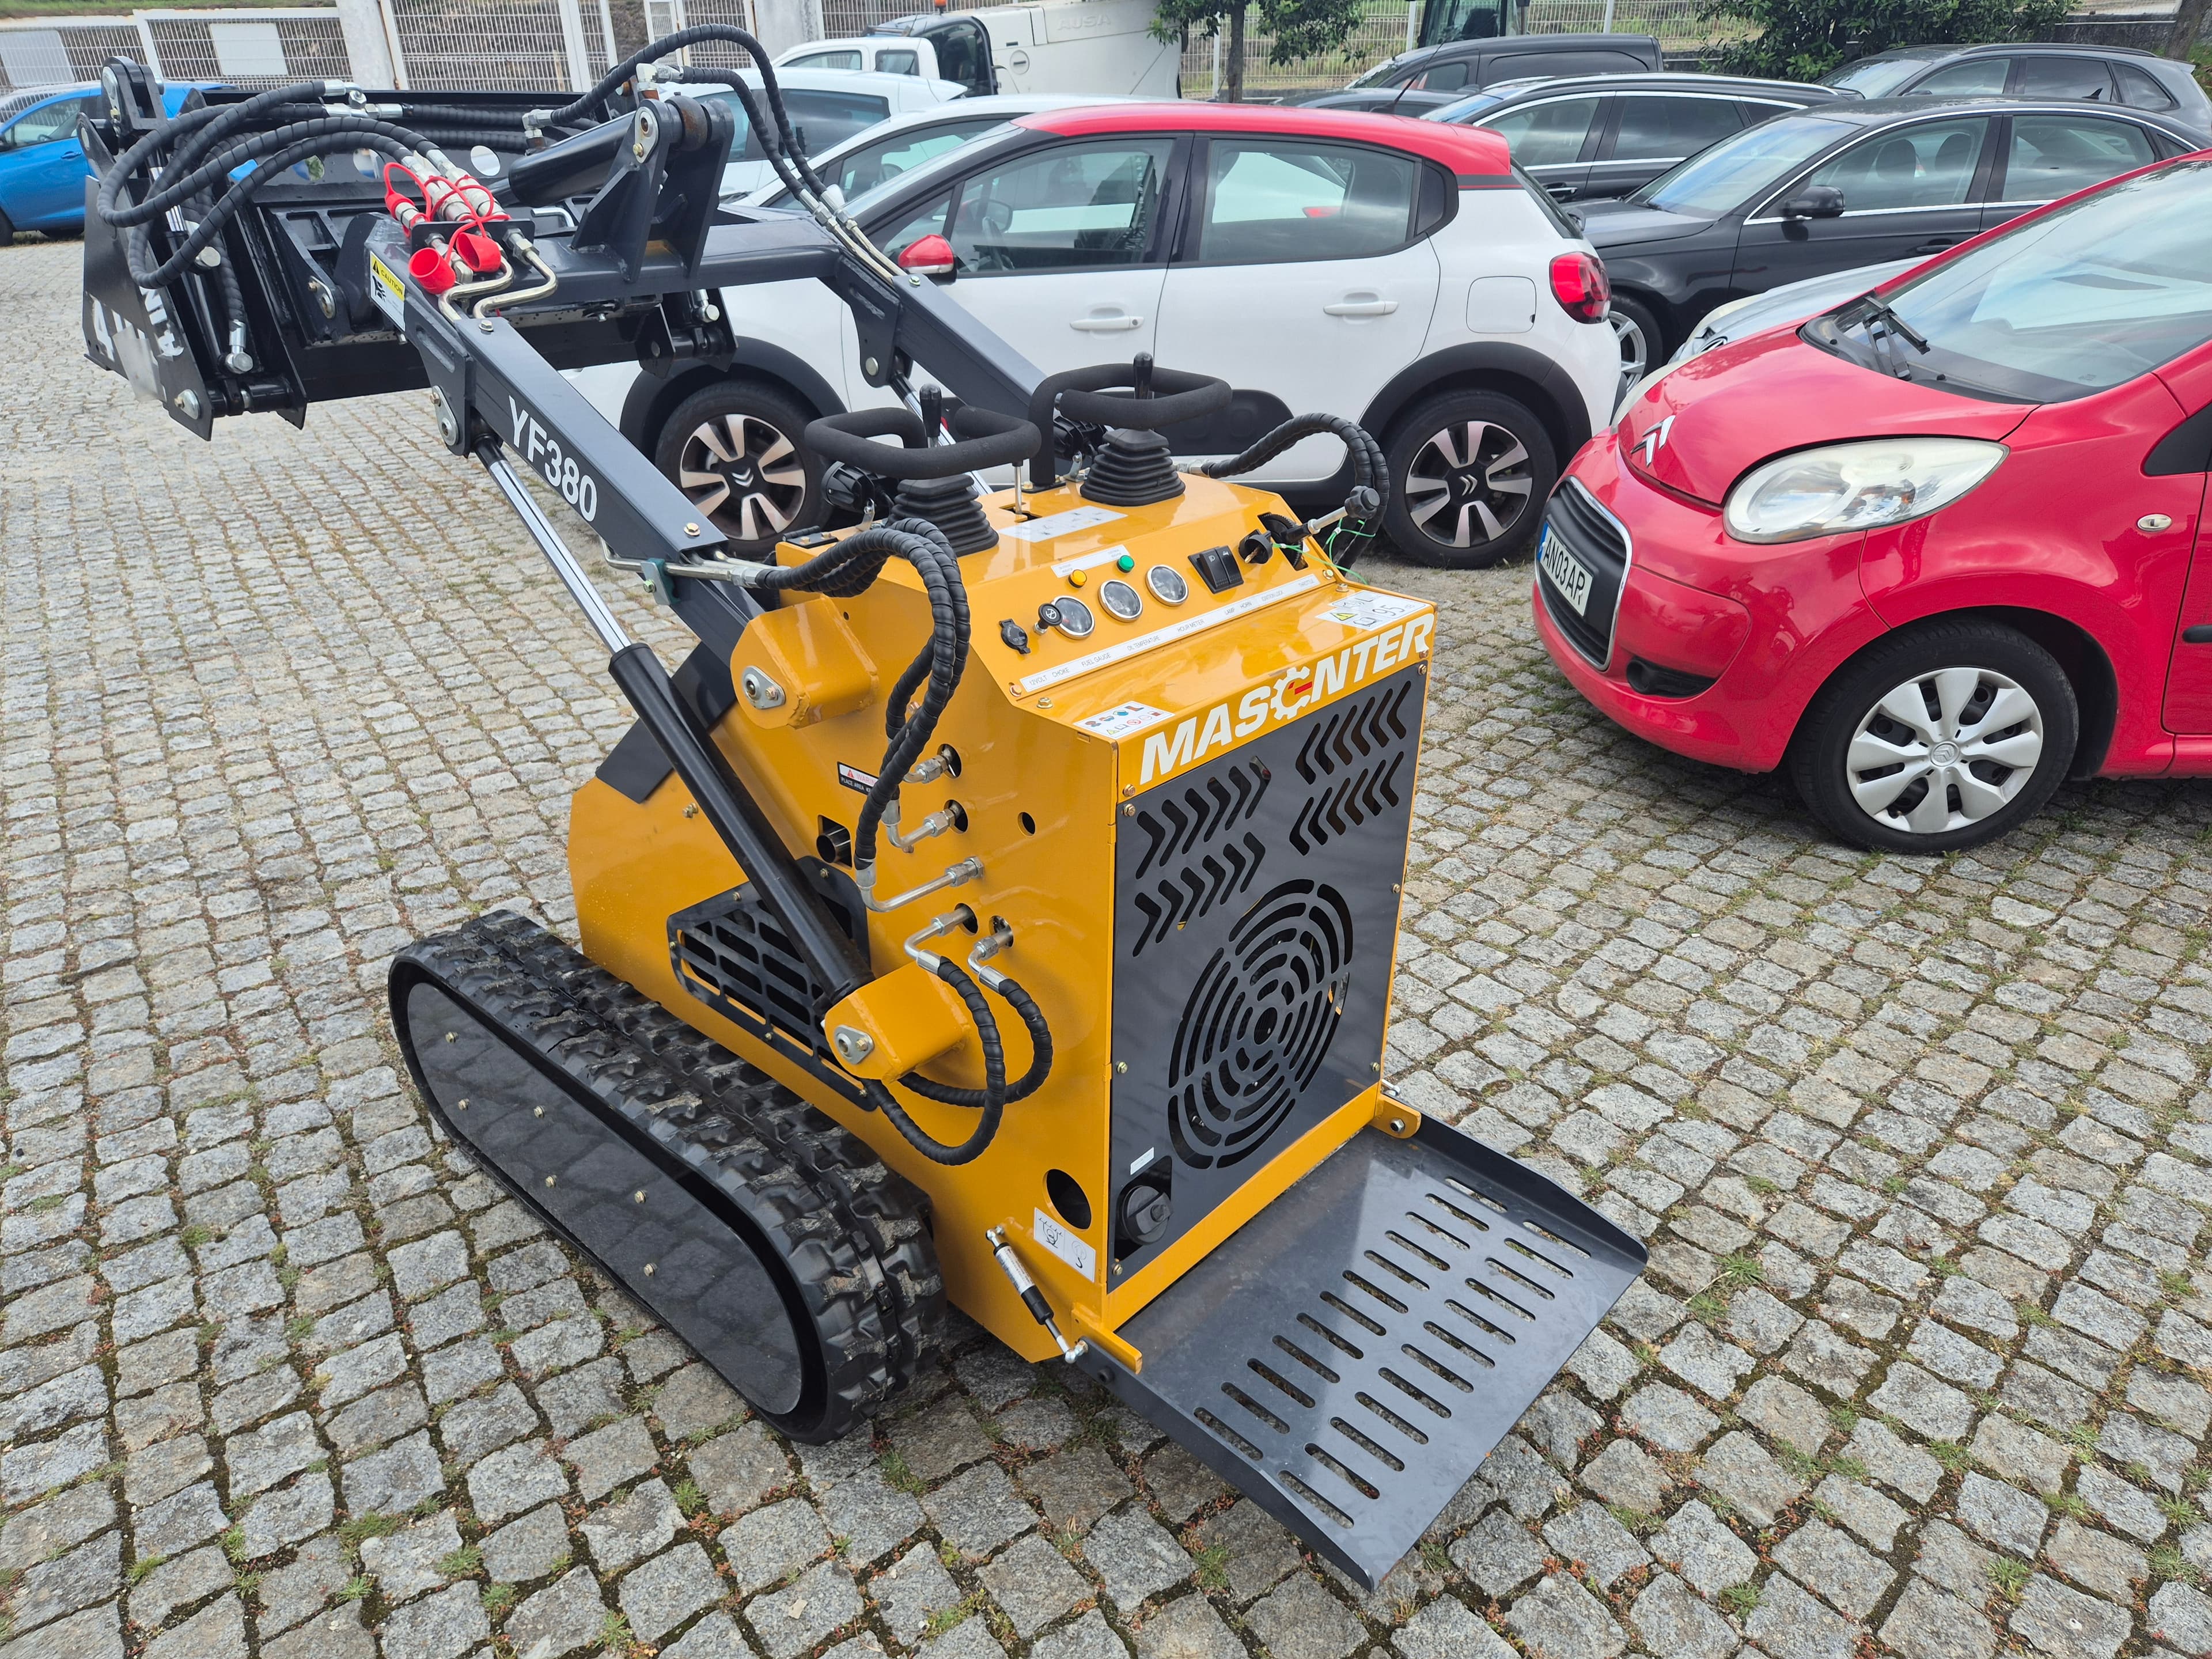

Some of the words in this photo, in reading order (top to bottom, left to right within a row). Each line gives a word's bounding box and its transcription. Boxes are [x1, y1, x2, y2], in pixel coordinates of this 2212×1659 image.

[1056, 13, 1111, 31] AUSA
[381, 269, 403, 296] CAUTION
[509, 395, 597, 522] YF380
[1372, 605, 1405, 616] 95
[1029, 675, 1048, 686] 12VOLT
[1051, 667, 1070, 678] CHOKE
[1081, 659, 1094, 667] FUEL
[1094, 652, 1111, 662] GAUGE
[1133, 635, 1161, 649] TEMPERATURE
[1177, 624, 1190, 632] HOUR
[1189, 619, 1205, 628] METER
[1225, 607, 1235, 615] LAMP
